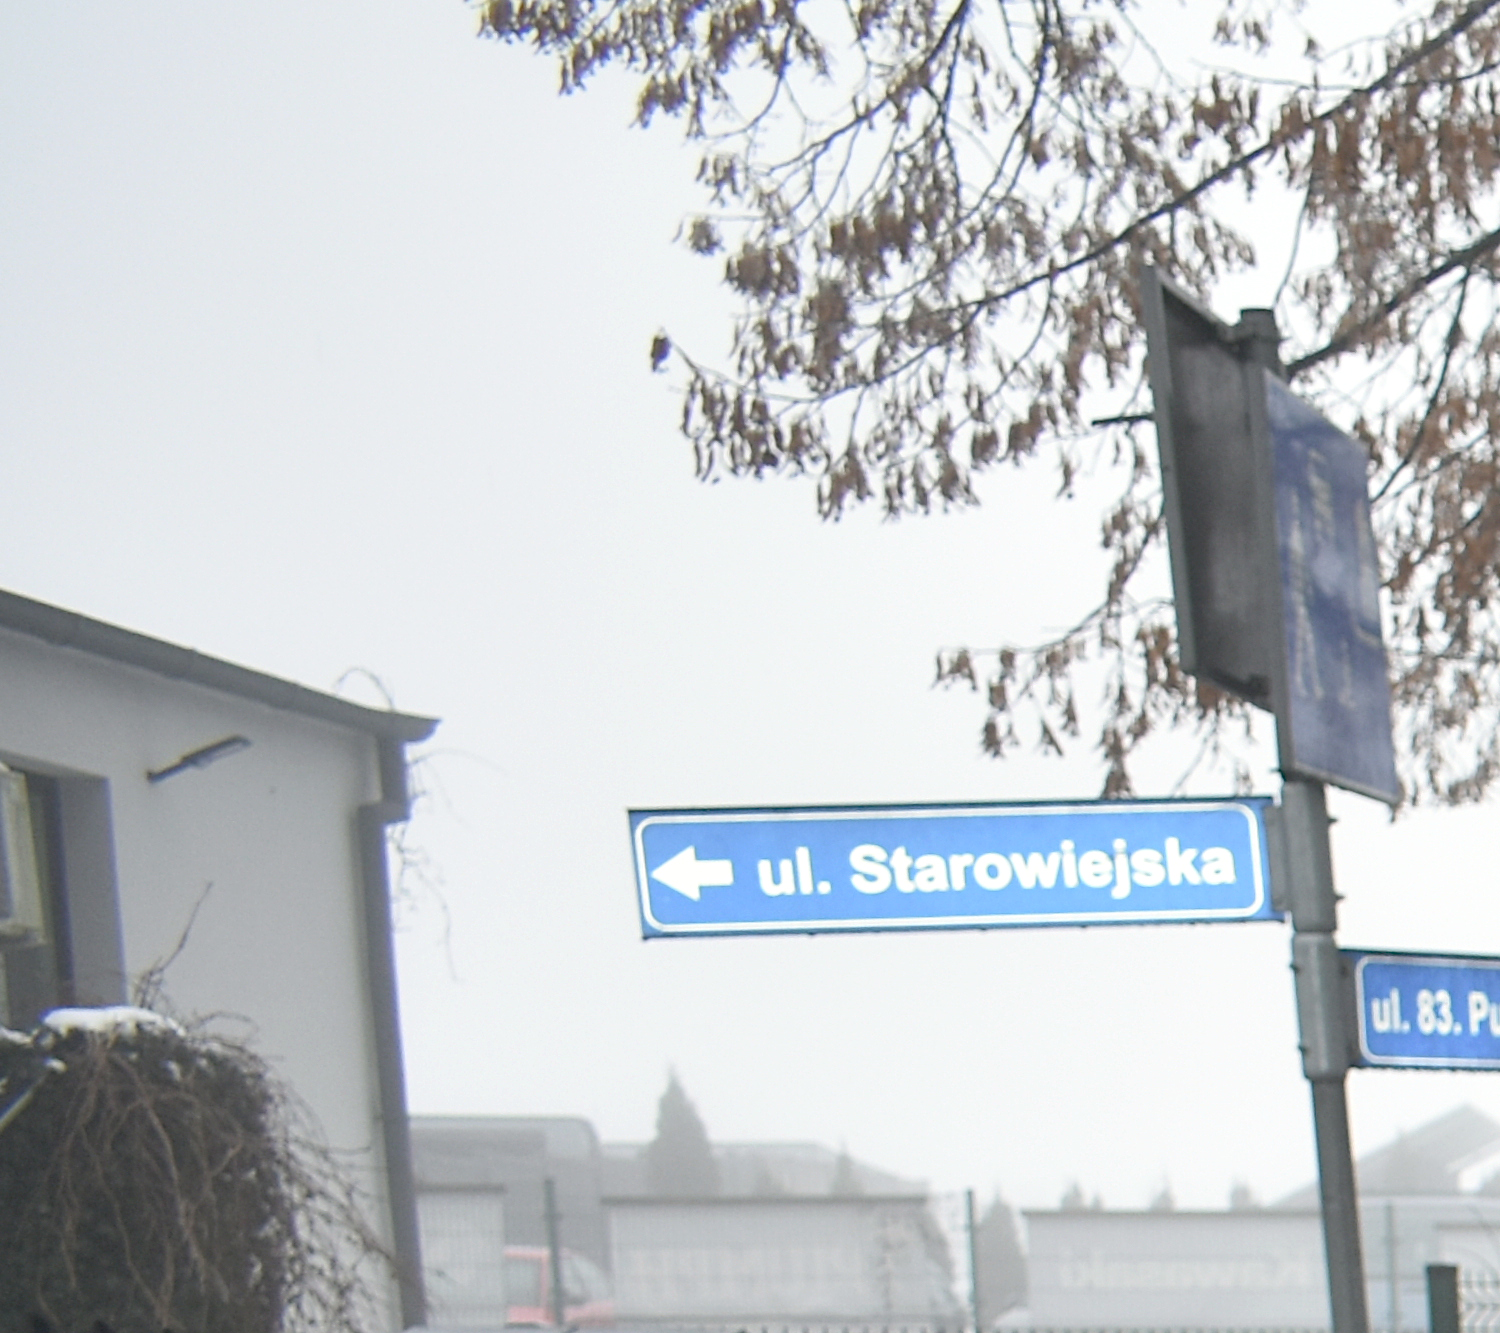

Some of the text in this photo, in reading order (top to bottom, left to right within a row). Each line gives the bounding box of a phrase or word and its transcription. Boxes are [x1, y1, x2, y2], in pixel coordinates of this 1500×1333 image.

[757, 836, 1237, 900] ul. Starowiejska
[1371, 987, 1411, 1034] ul.
[1416, 989, 1463, 1035] 83.
